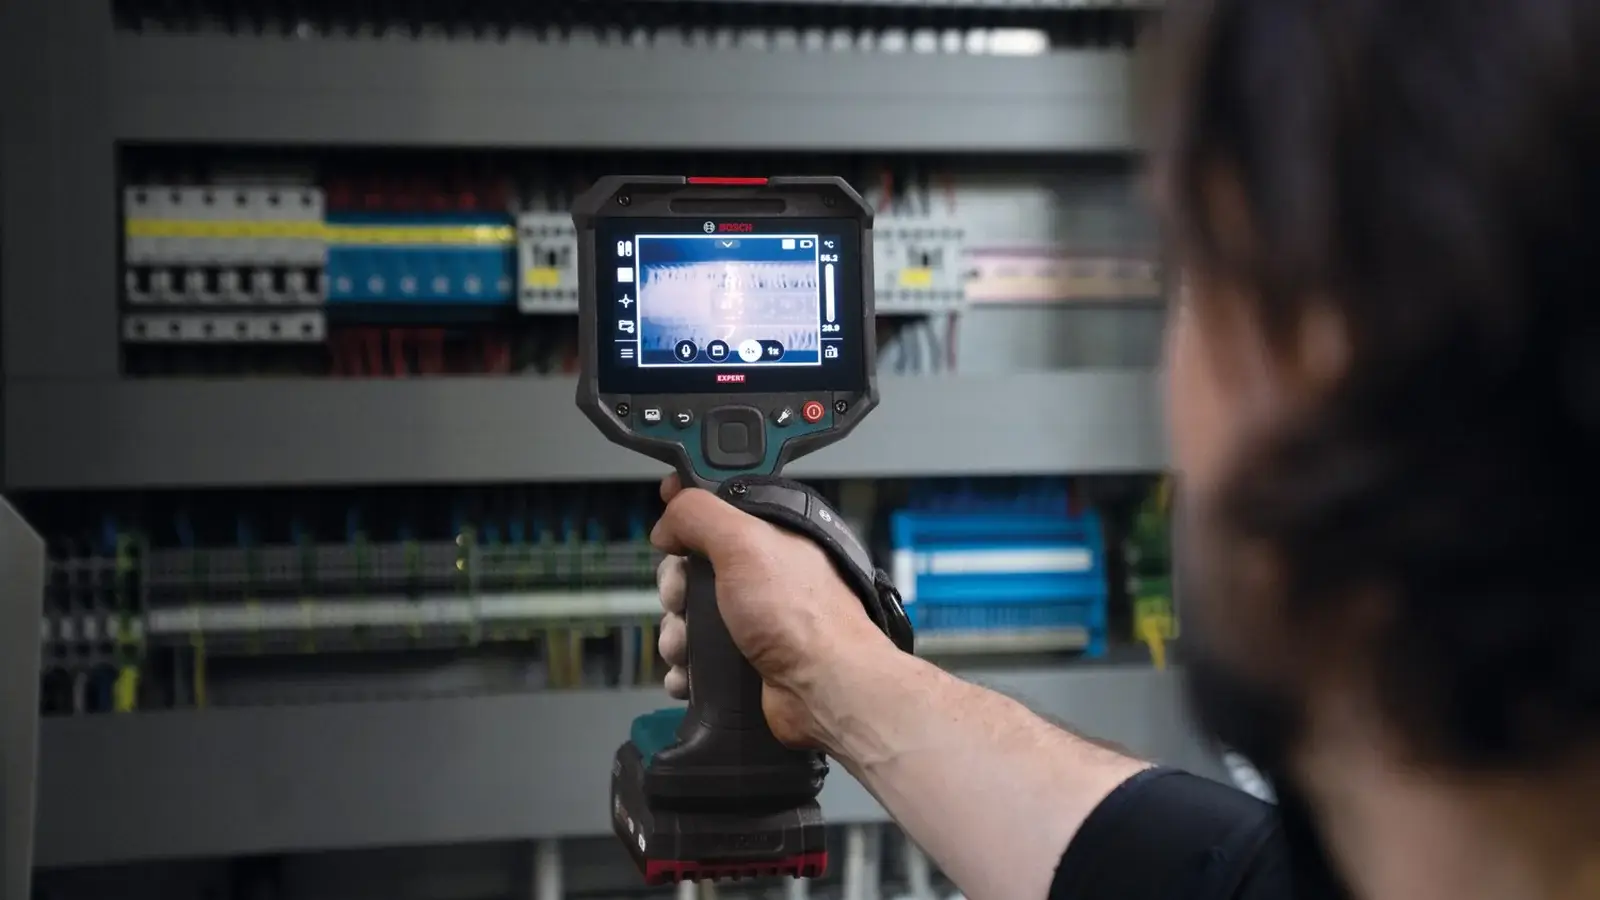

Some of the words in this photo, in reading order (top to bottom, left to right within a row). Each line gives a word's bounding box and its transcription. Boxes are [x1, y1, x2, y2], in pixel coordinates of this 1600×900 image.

[718, 223, 752, 232] BOSCH
[767, 346, 779, 356] 1x
[717, 374, 745, 382] EXPERT
